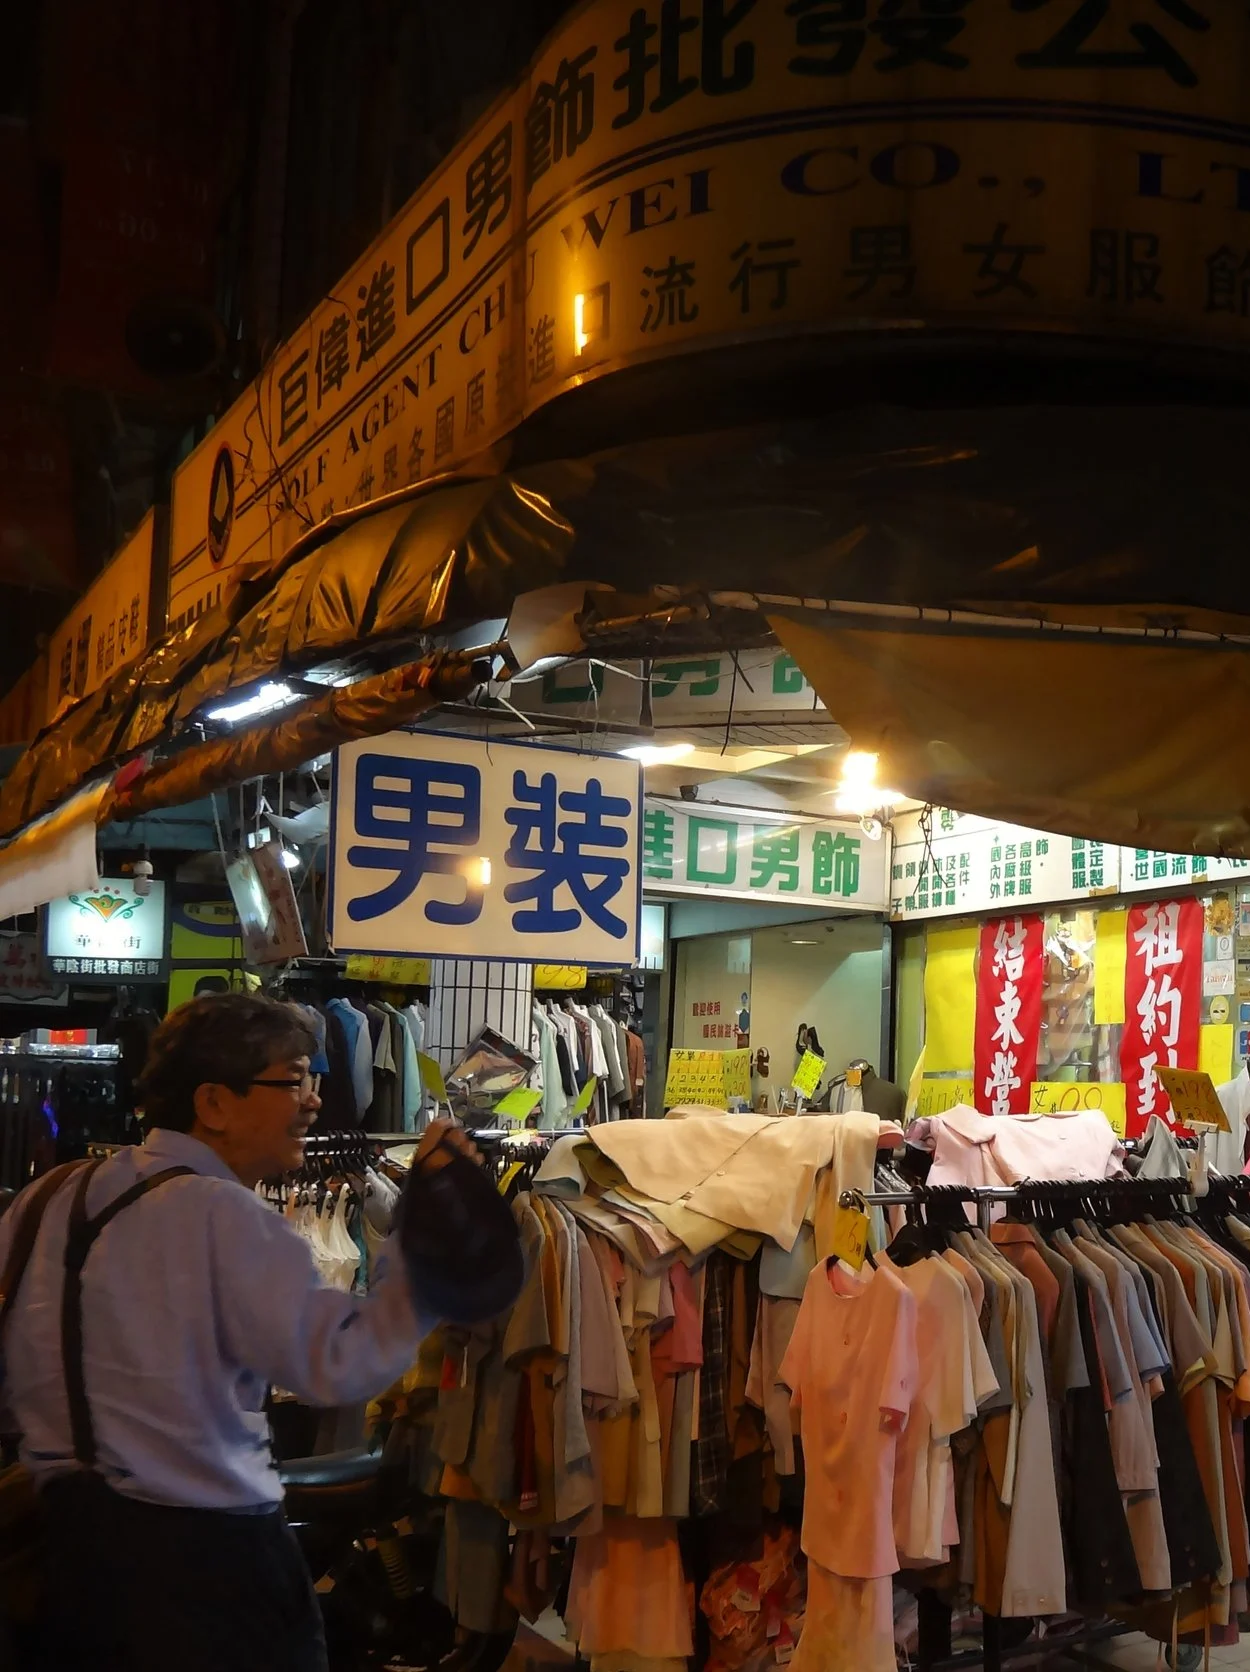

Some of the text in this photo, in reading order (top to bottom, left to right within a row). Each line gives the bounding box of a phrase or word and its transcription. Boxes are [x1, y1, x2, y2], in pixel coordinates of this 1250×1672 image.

[342, 343, 443, 464] AGENT
[561, 165, 715, 252] WEI
[346, 752, 632, 940] 男裝
